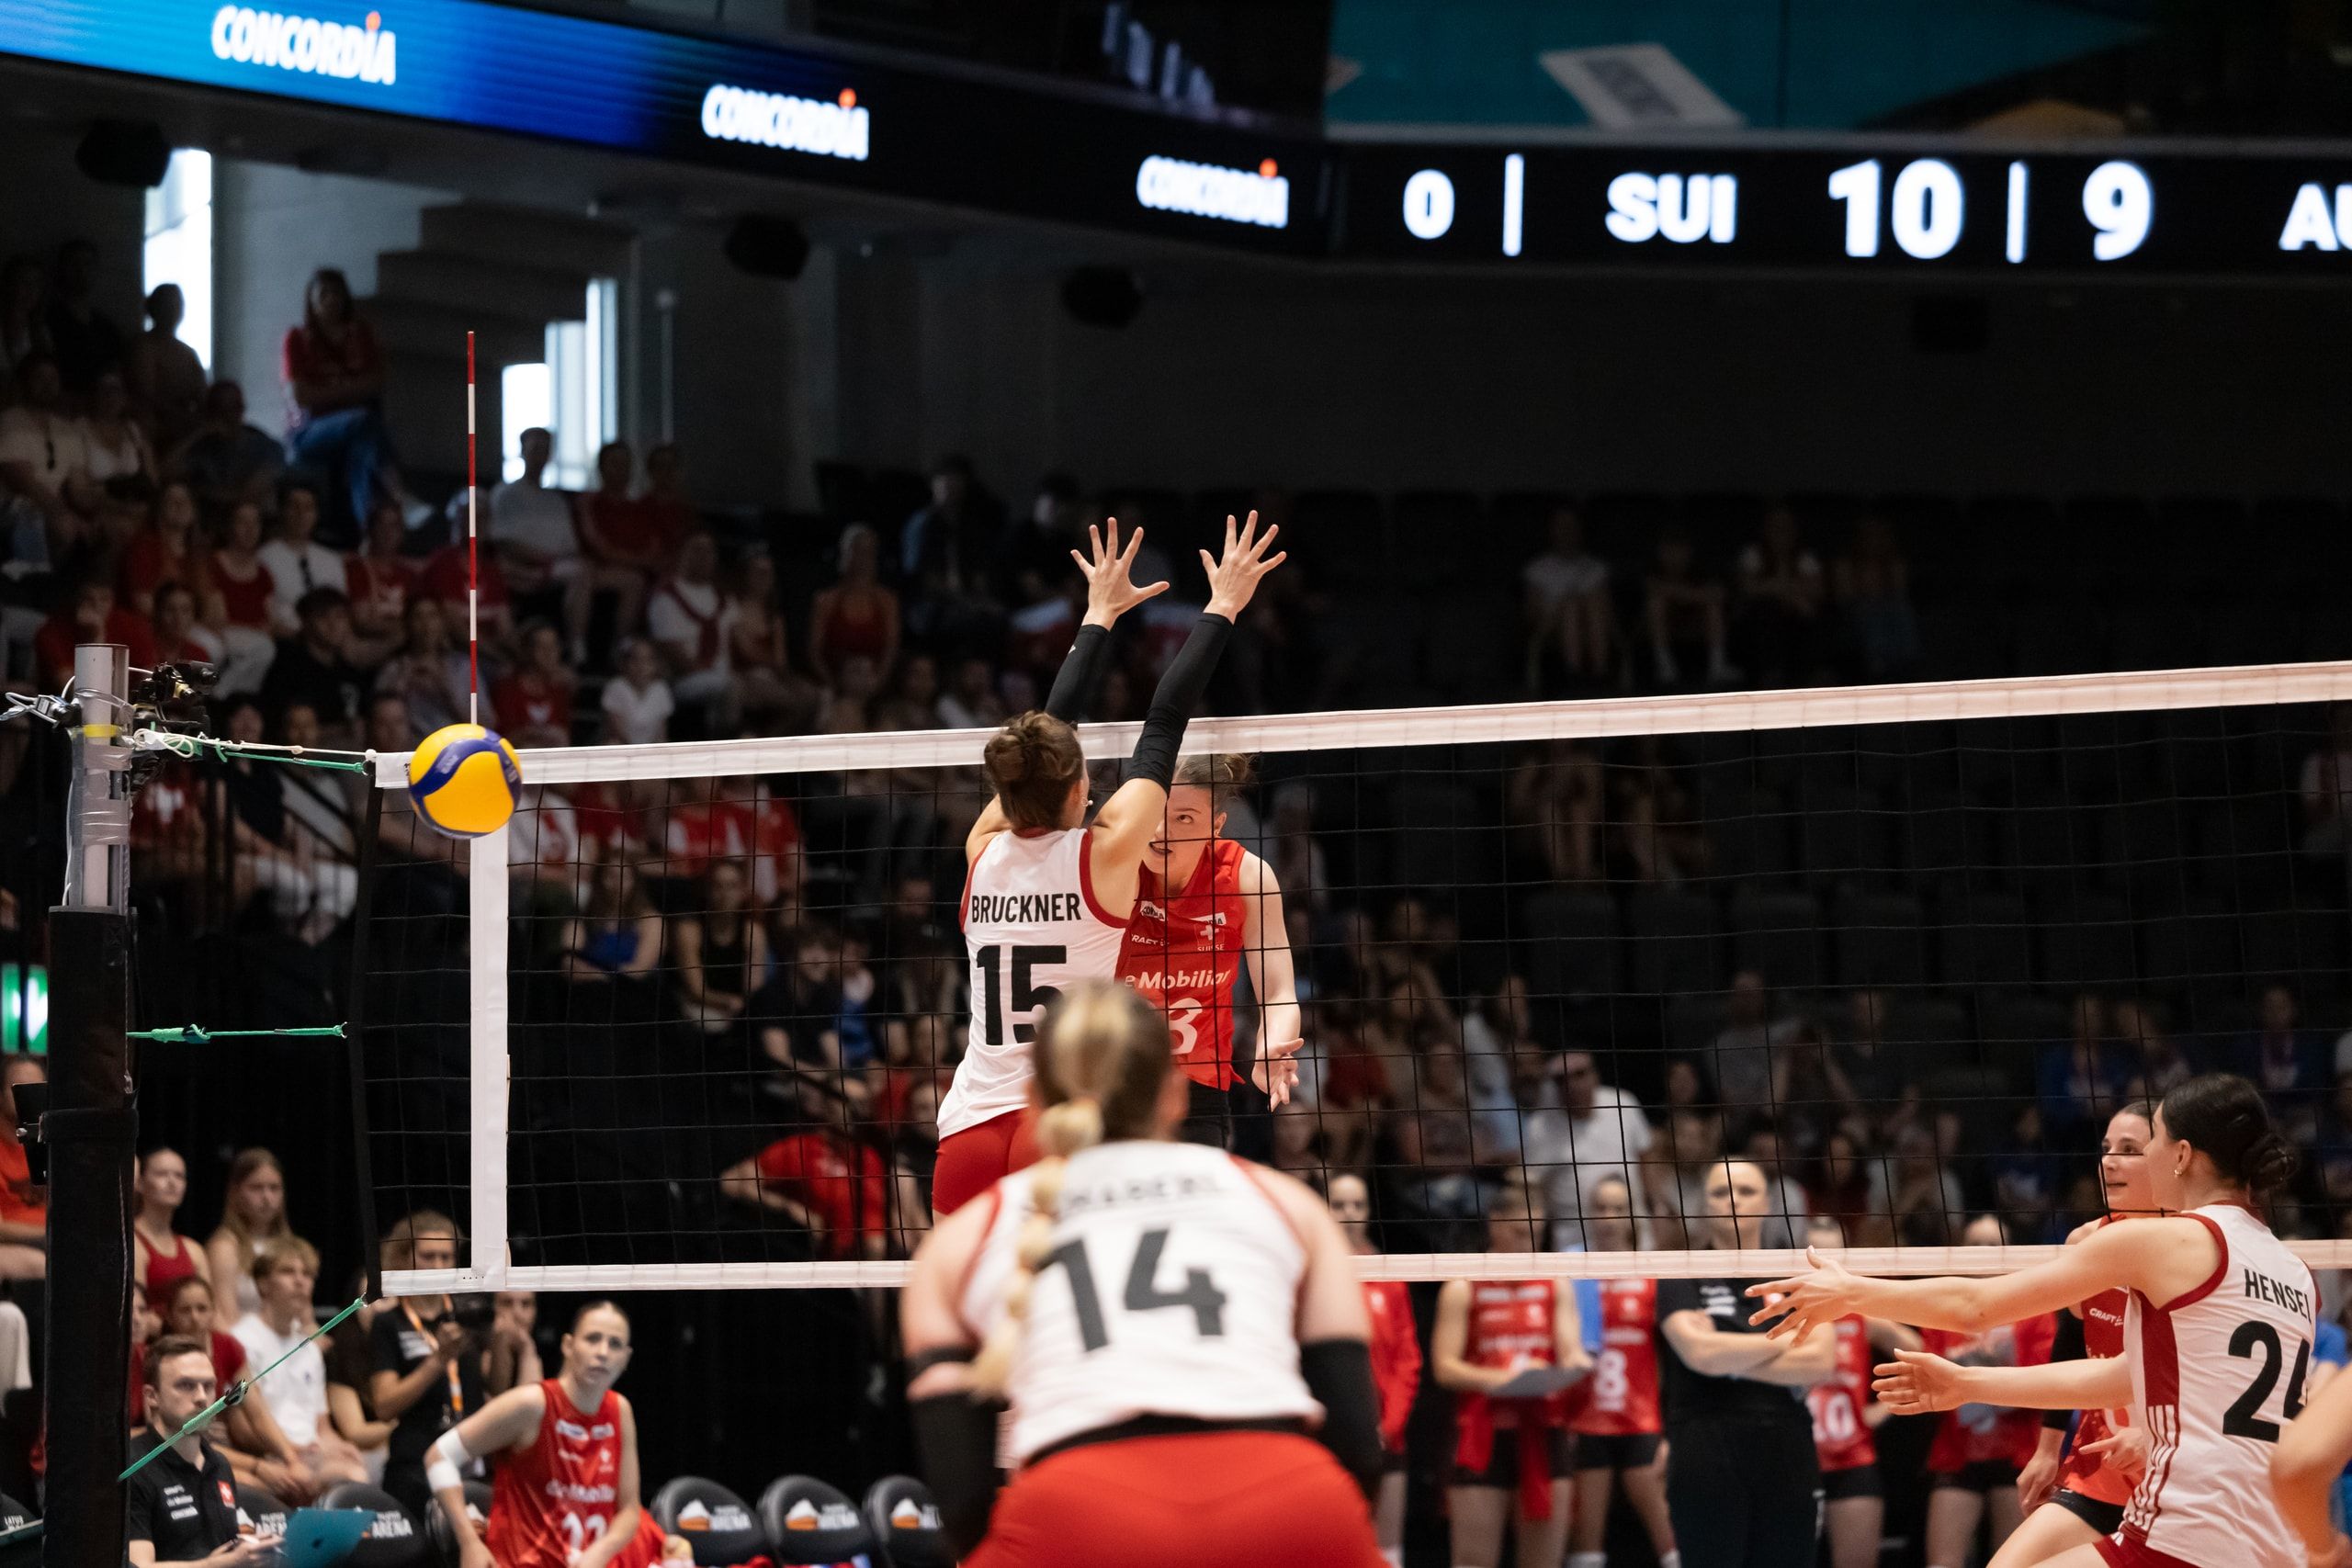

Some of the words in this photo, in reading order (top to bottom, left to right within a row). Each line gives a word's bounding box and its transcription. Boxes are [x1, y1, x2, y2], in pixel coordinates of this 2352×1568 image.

[211, 5, 396, 85] CONCORDIA
[702, 87, 868, 161] CONCORDIA
[1605, 172, 1737, 243] SUI
[1828, 159, 1964, 259] 10
[2083, 161, 2153, 261] 9
[971, 893, 1082, 923] BRUCKNER
[976, 944, 1067, 1046] 15
[1033, 1227, 1227, 1351] 14
[2089, 1307, 2117, 1323] CRAFT
